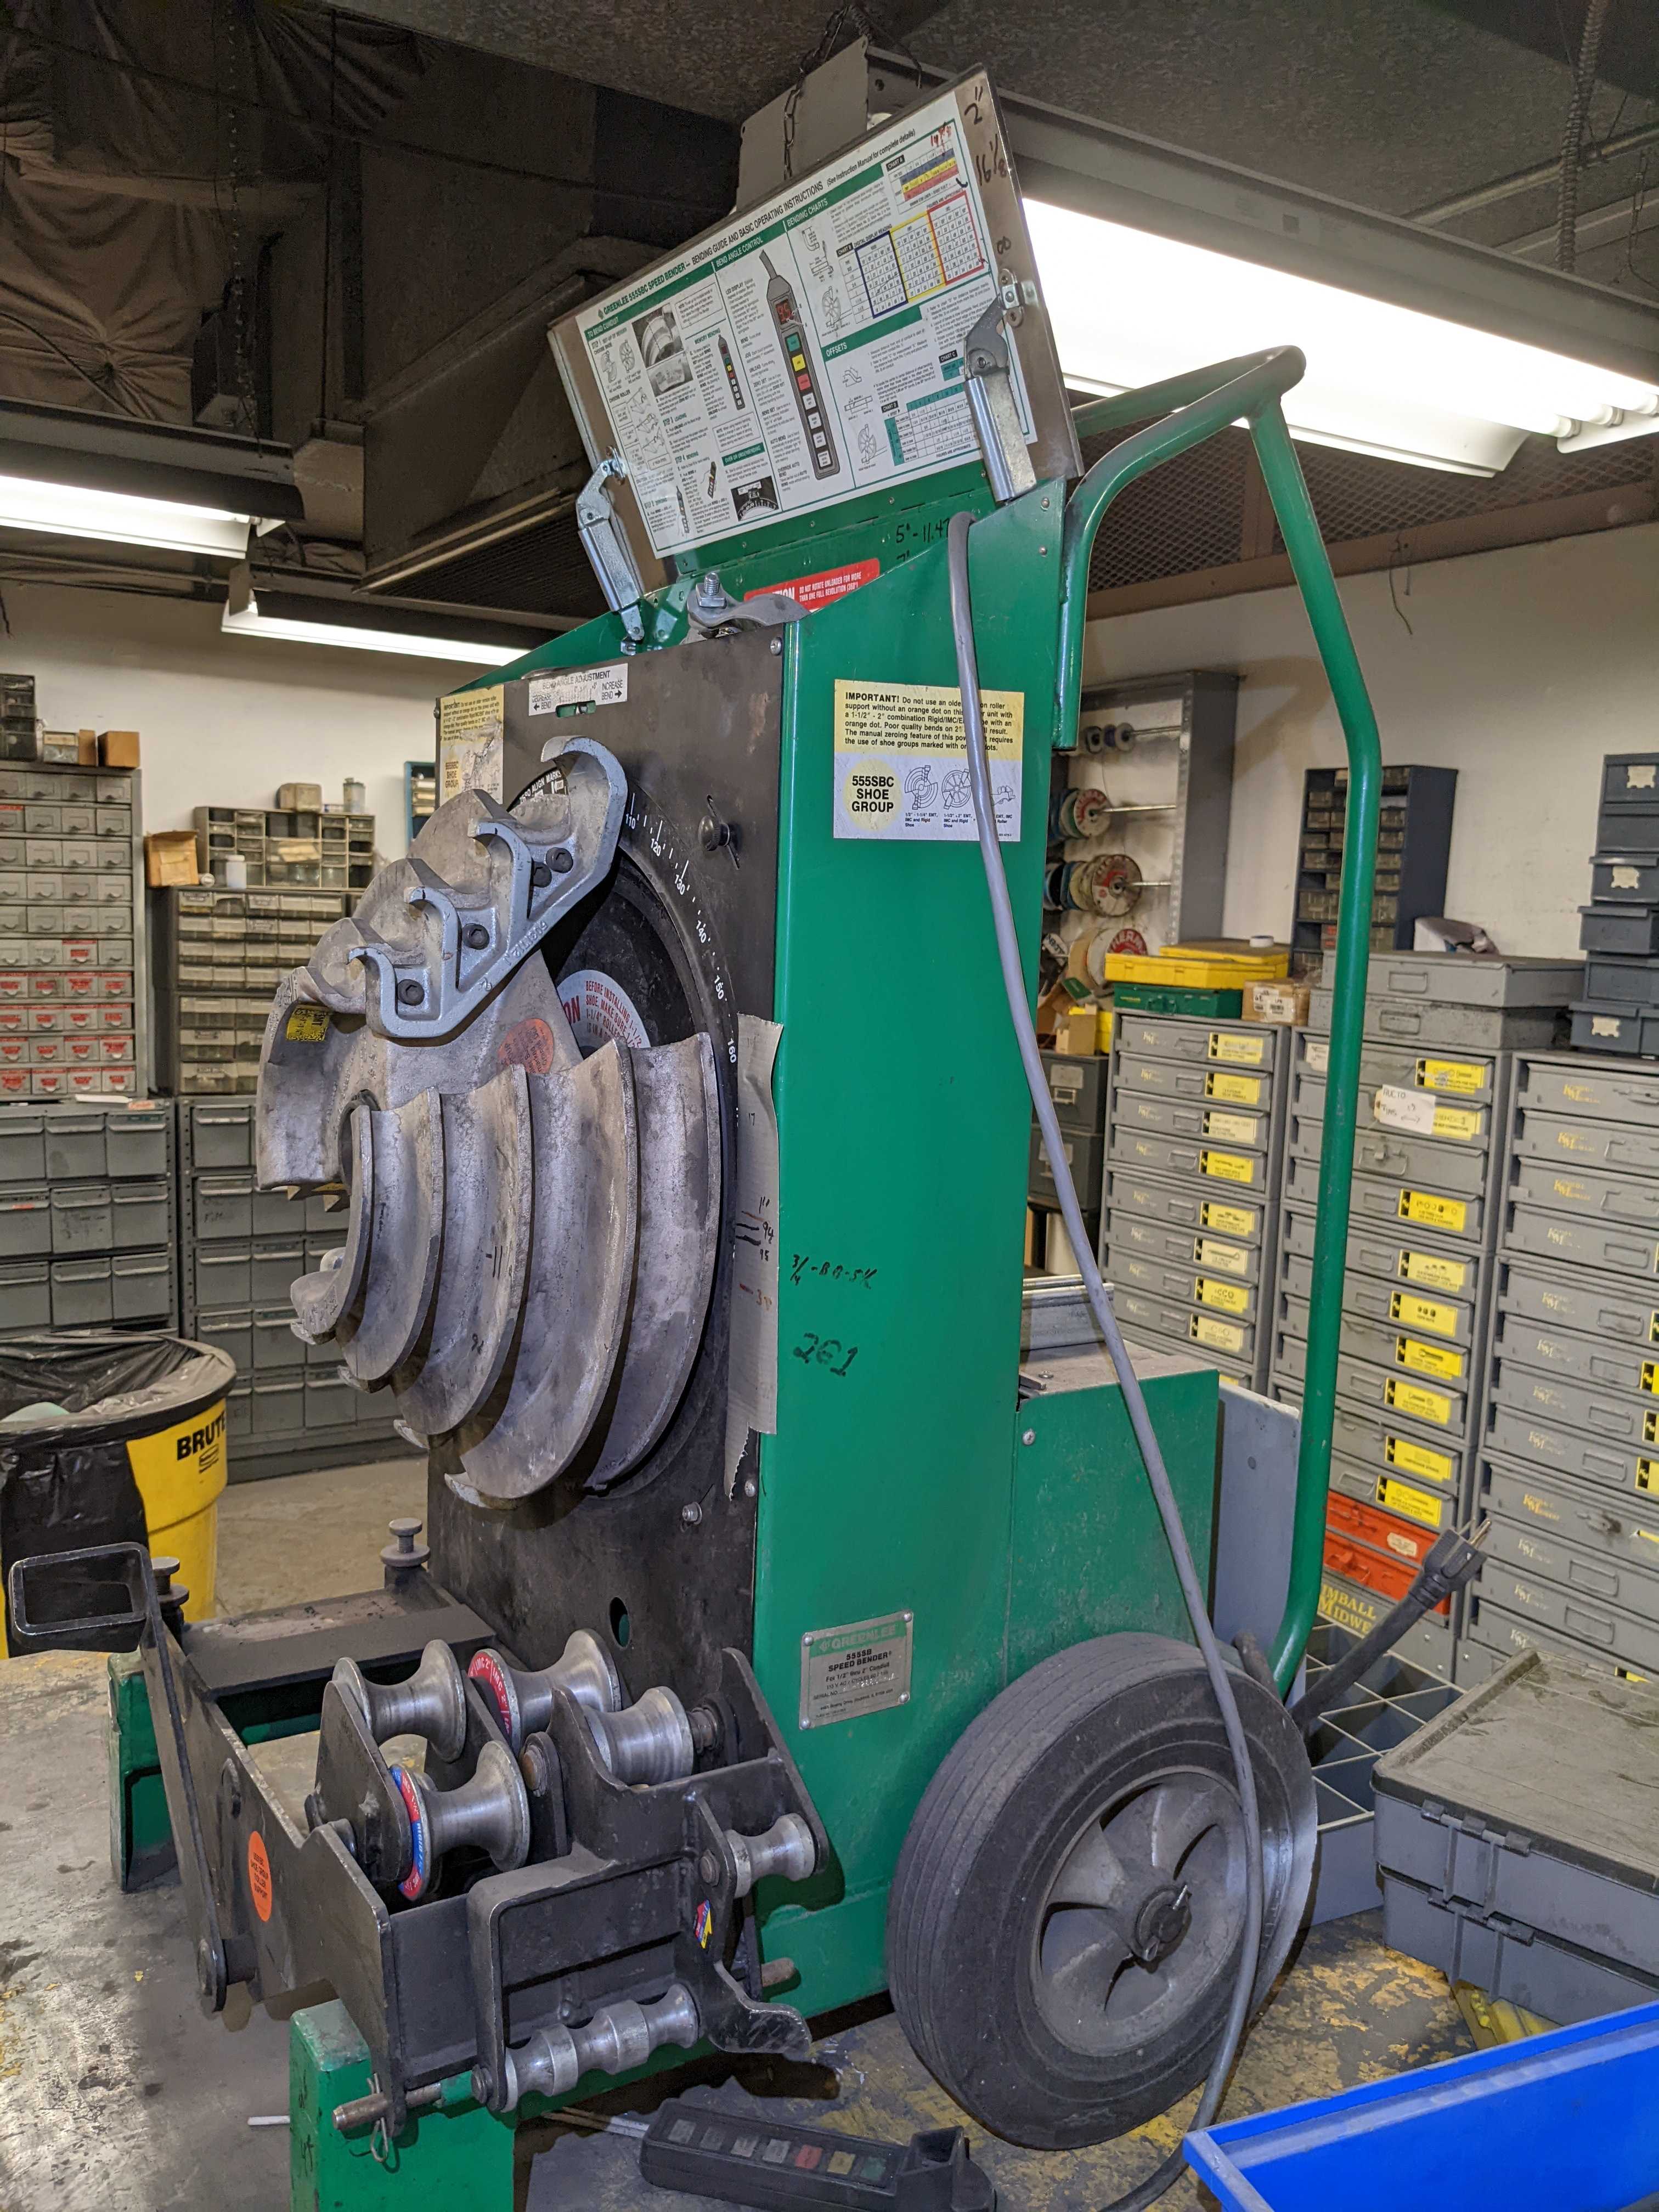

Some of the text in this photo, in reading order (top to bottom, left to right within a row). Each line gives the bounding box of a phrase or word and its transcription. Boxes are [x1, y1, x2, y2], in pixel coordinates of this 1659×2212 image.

[786, 198, 828, 227] BENDING CHARTS
[603, 295, 629, 315] GREENLEE
[628, 283, 648, 301] 555SBC
[647, 273, 665, 290] SPEED
[663, 261, 686, 280] BENDER
[691, 247, 712, 265] BENDING
[712, 238, 728, 253] GUIDE
[727, 231, 738, 244] AND
[738, 222, 754, 238] BASIC
[753, 204, 783, 229] OPERATING
[783, 180, 823, 211] INSTRUCTIONS
[826, 175, 836, 186] (See
[836, 163, 857, 180] Instruction
[857, 153, 873, 167] Manual
[879, 138, 899, 155] complete
[899, 128, 916, 144] details)
[837, 223, 892, 256] CHART DIGITAL DISPLAY READING
[715, 235, 763, 268] BEND ANGLE CONTROL
[826, 342, 847, 357] OFFSETS
[940, 353, 952, 361] CHART
[882, 403, 893, 411] CHART
[825, 586, 846, 596] REVOLUTION
[845, 692, 899, 703] IMPORTANT!
[845, 703, 870, 712] support
[873, 703, 896, 712] without
[887, 714, 925, 722] combination
[901, 723, 922, 731] quality
[884, 731, 907, 740] zeroing
[532, 777, 545, 793] ALIGN
[546, 770, 562, 784] MARKS
[852, 776, 894, 787] 555SBC
[856, 789, 889, 800] SHOE
[851, 801, 894, 812] GROUP
[625, 814, 636, 830] 110
[651, 838, 661, 856] 120
[675, 874, 685, 895] 130
[696, 920, 706, 944] 140
[714, 975, 724, 1000] 150
[586, 980, 603, 995] BEFORE
[604, 987, 630, 1023] INSTALLING
[601, 1000, 614, 1018] MAKE
[614, 1013, 627, 1035] SURE
[727, 1038, 737, 1063] 160
[177, 1411, 225, 1460] BRUTE
[1318, 1595, 1372, 1633] MIDWE
[831, 1624, 896, 1649] GREENLEE
[847, 1649, 872, 1660] 555SB
[476, 1657, 485, 1671] IMC
[828, 1660, 854, 1672] SPEED
[869, 1662, 889, 1672] Conduit
[492, 1667, 503, 1691] IMC
